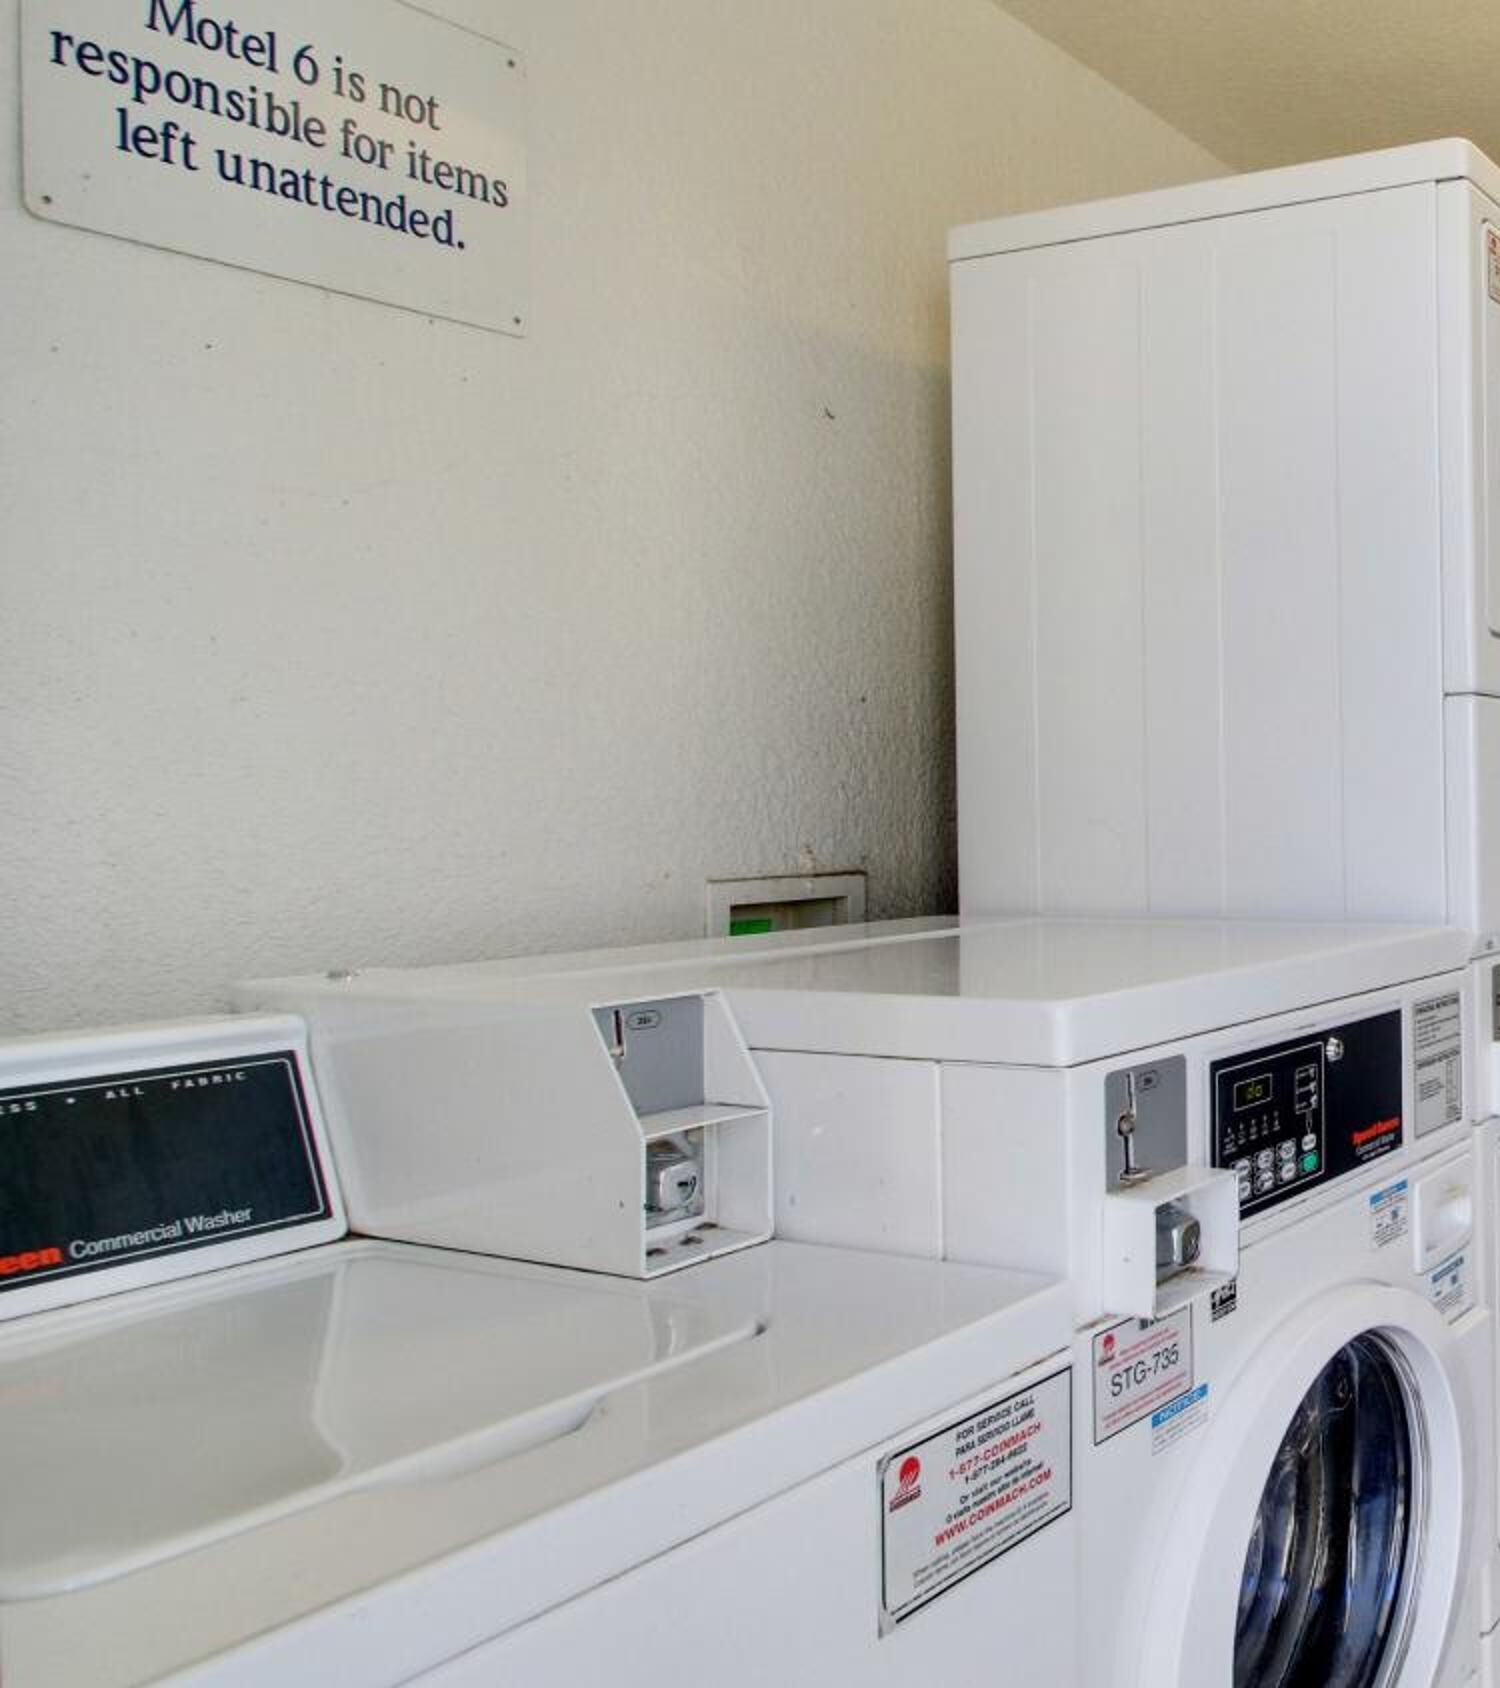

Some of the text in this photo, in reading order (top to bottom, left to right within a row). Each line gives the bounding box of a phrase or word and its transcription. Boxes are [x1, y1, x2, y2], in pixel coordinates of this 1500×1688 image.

[144, 0, 441, 131] Motel 6 is not
[50, 29, 508, 207] responsible for items
[115, 107, 465, 250] left unattended.
[105, 1087, 144, 1099] ALL
[171, 1071, 246, 1090] FABRIC
[69, 1220, 182, 1258] Commercial
[184, 1208, 253, 1233] Washer
[956, 1426, 975, 1441] FOR
[976, 1405, 1012, 1432] SERVICE
